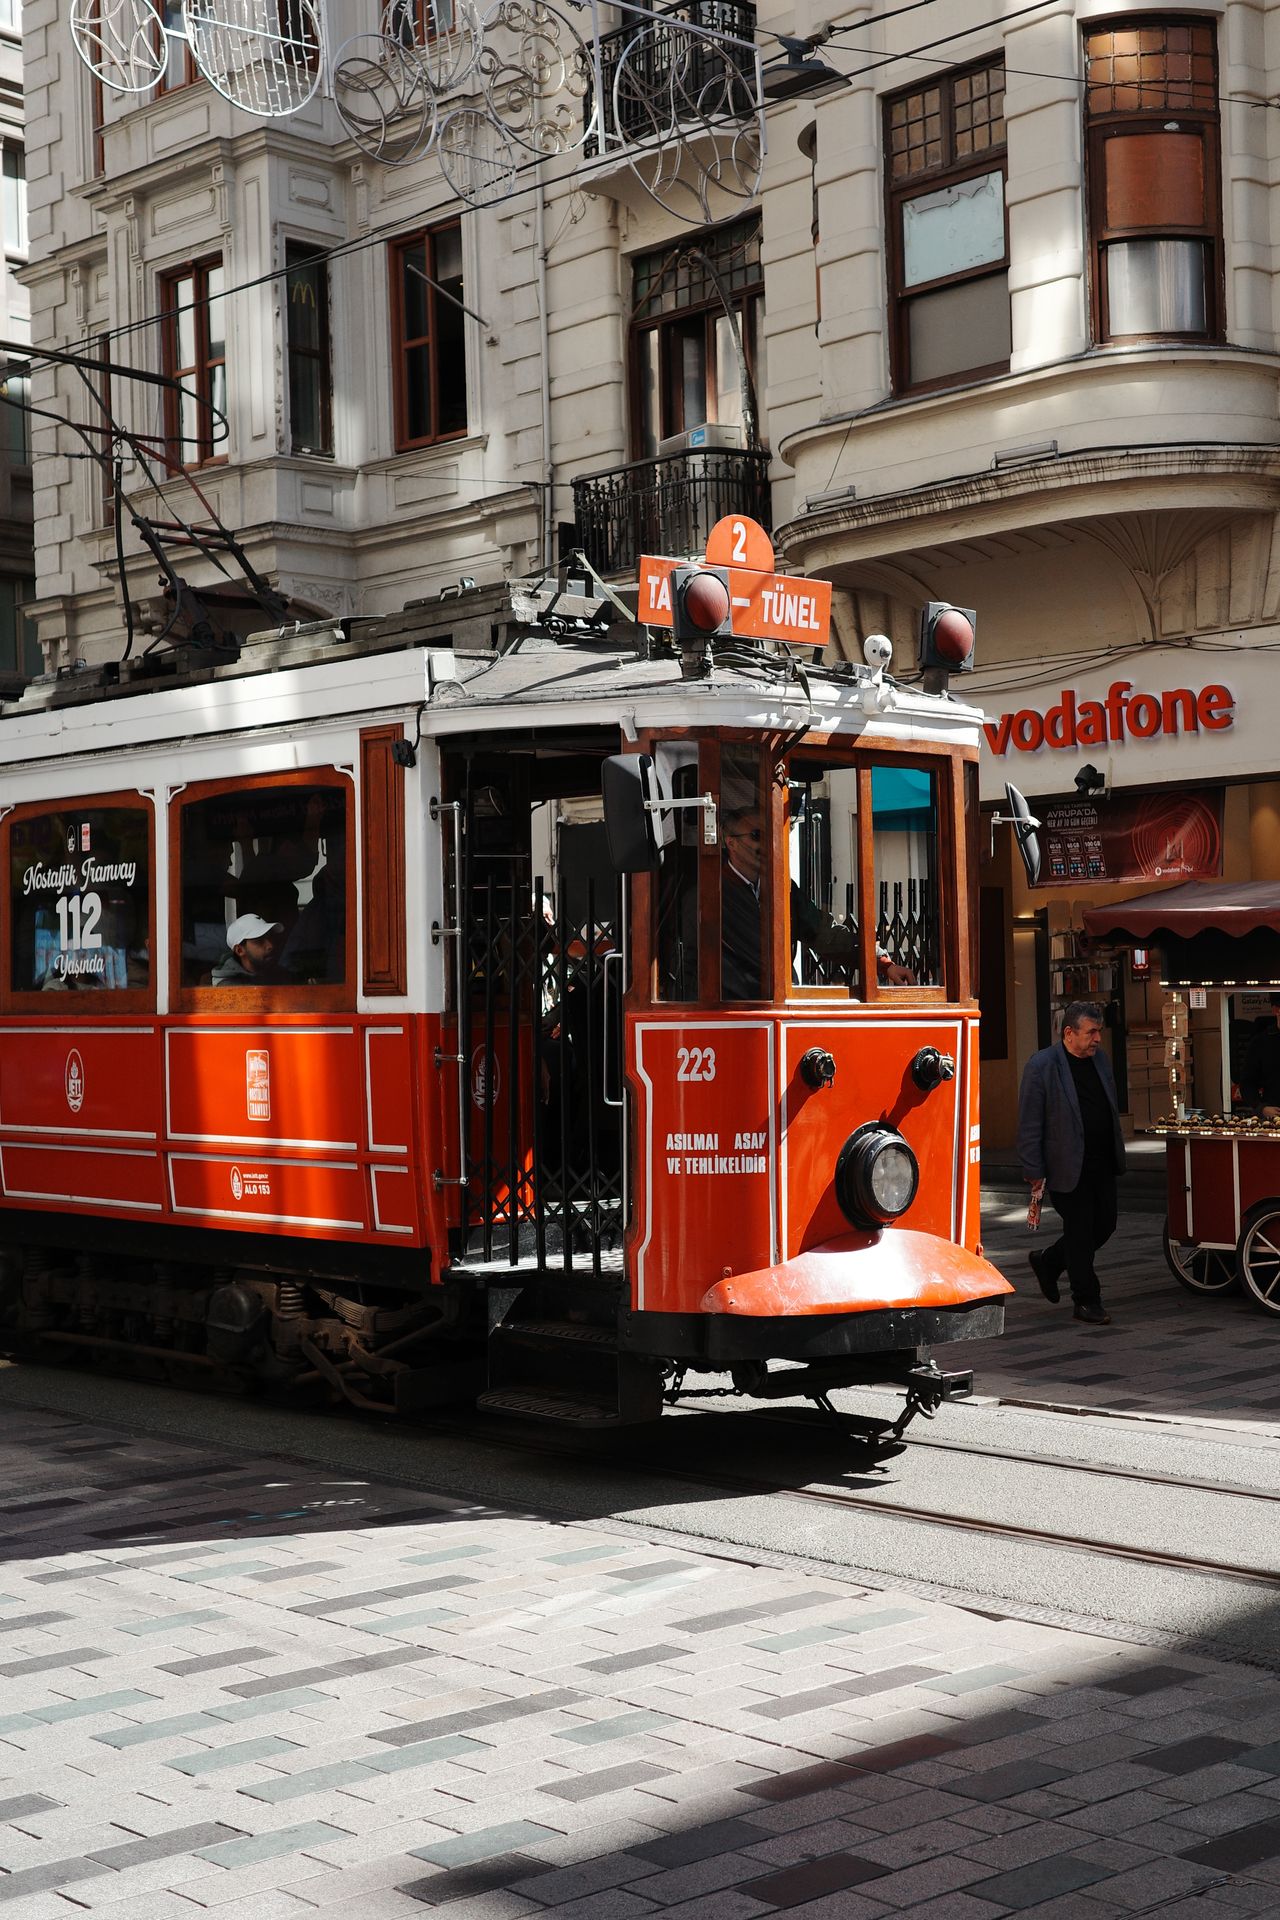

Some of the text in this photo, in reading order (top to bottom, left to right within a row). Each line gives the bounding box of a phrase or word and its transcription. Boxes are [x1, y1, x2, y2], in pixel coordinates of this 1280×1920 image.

[732, 522, 747, 563] 2
[761, 584, 820, 630] TÜNEL
[983, 681, 1236, 755] vodafone
[1046, 808, 1098, 819] AVRUPA'DA
[23, 856, 136, 895] Nostaljik Tramvay
[55, 892, 102, 951] 112
[54, 953, 104, 982] Yaşında
[676, 1047, 716, 1082] 223
[666, 1154, 767, 1175] VE TEHLİKELİDİR
[244, 1184, 257, 1194] ALO
[258, 1184, 270, 1195] 153
